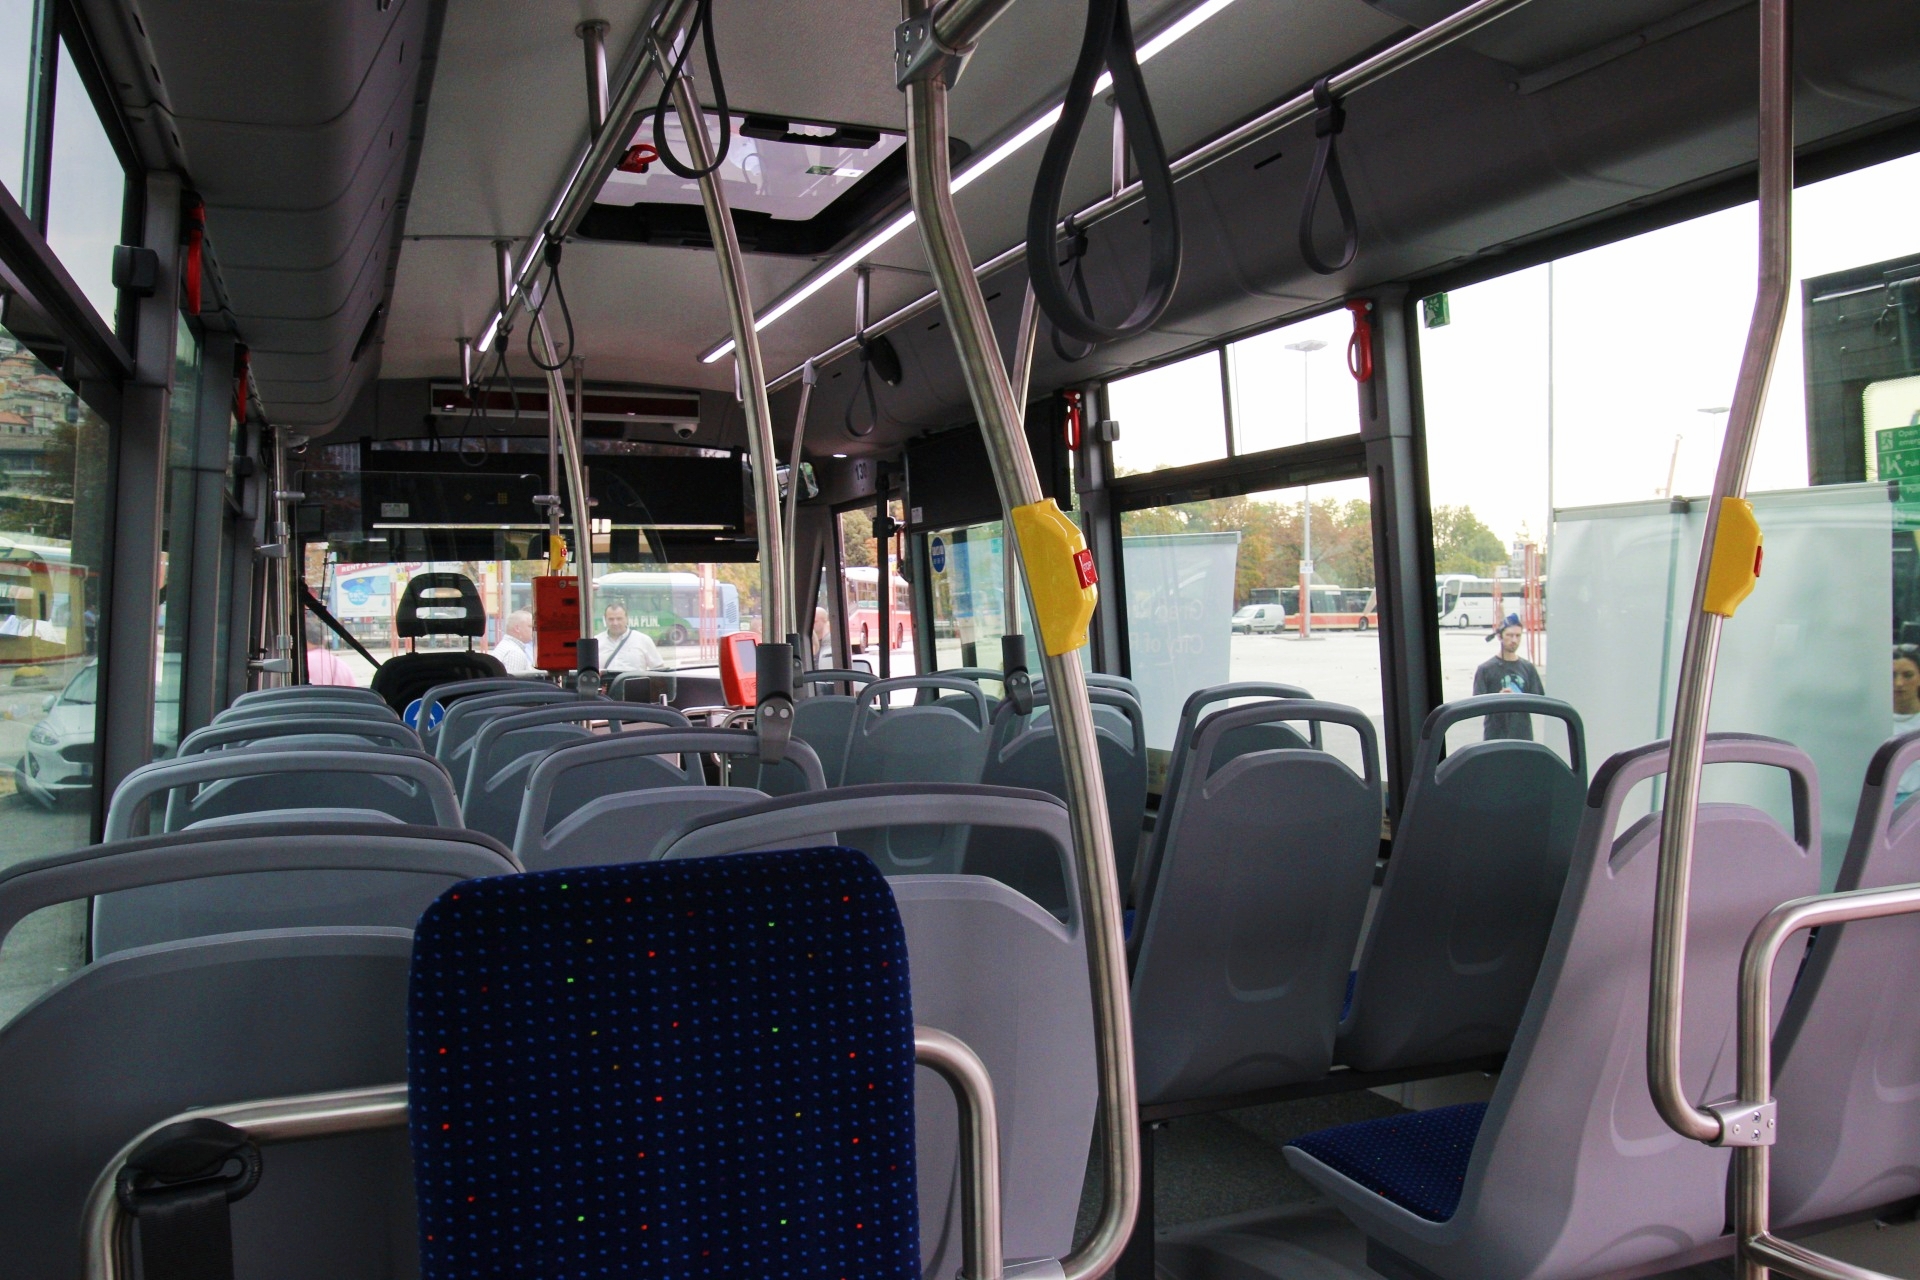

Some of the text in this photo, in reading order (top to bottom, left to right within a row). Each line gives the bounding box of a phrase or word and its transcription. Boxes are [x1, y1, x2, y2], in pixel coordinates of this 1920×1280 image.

[1899, 430, 1918, 438] Open
[341, 563, 361, 572] RENT
[1082, 560, 1092, 572] STOP
